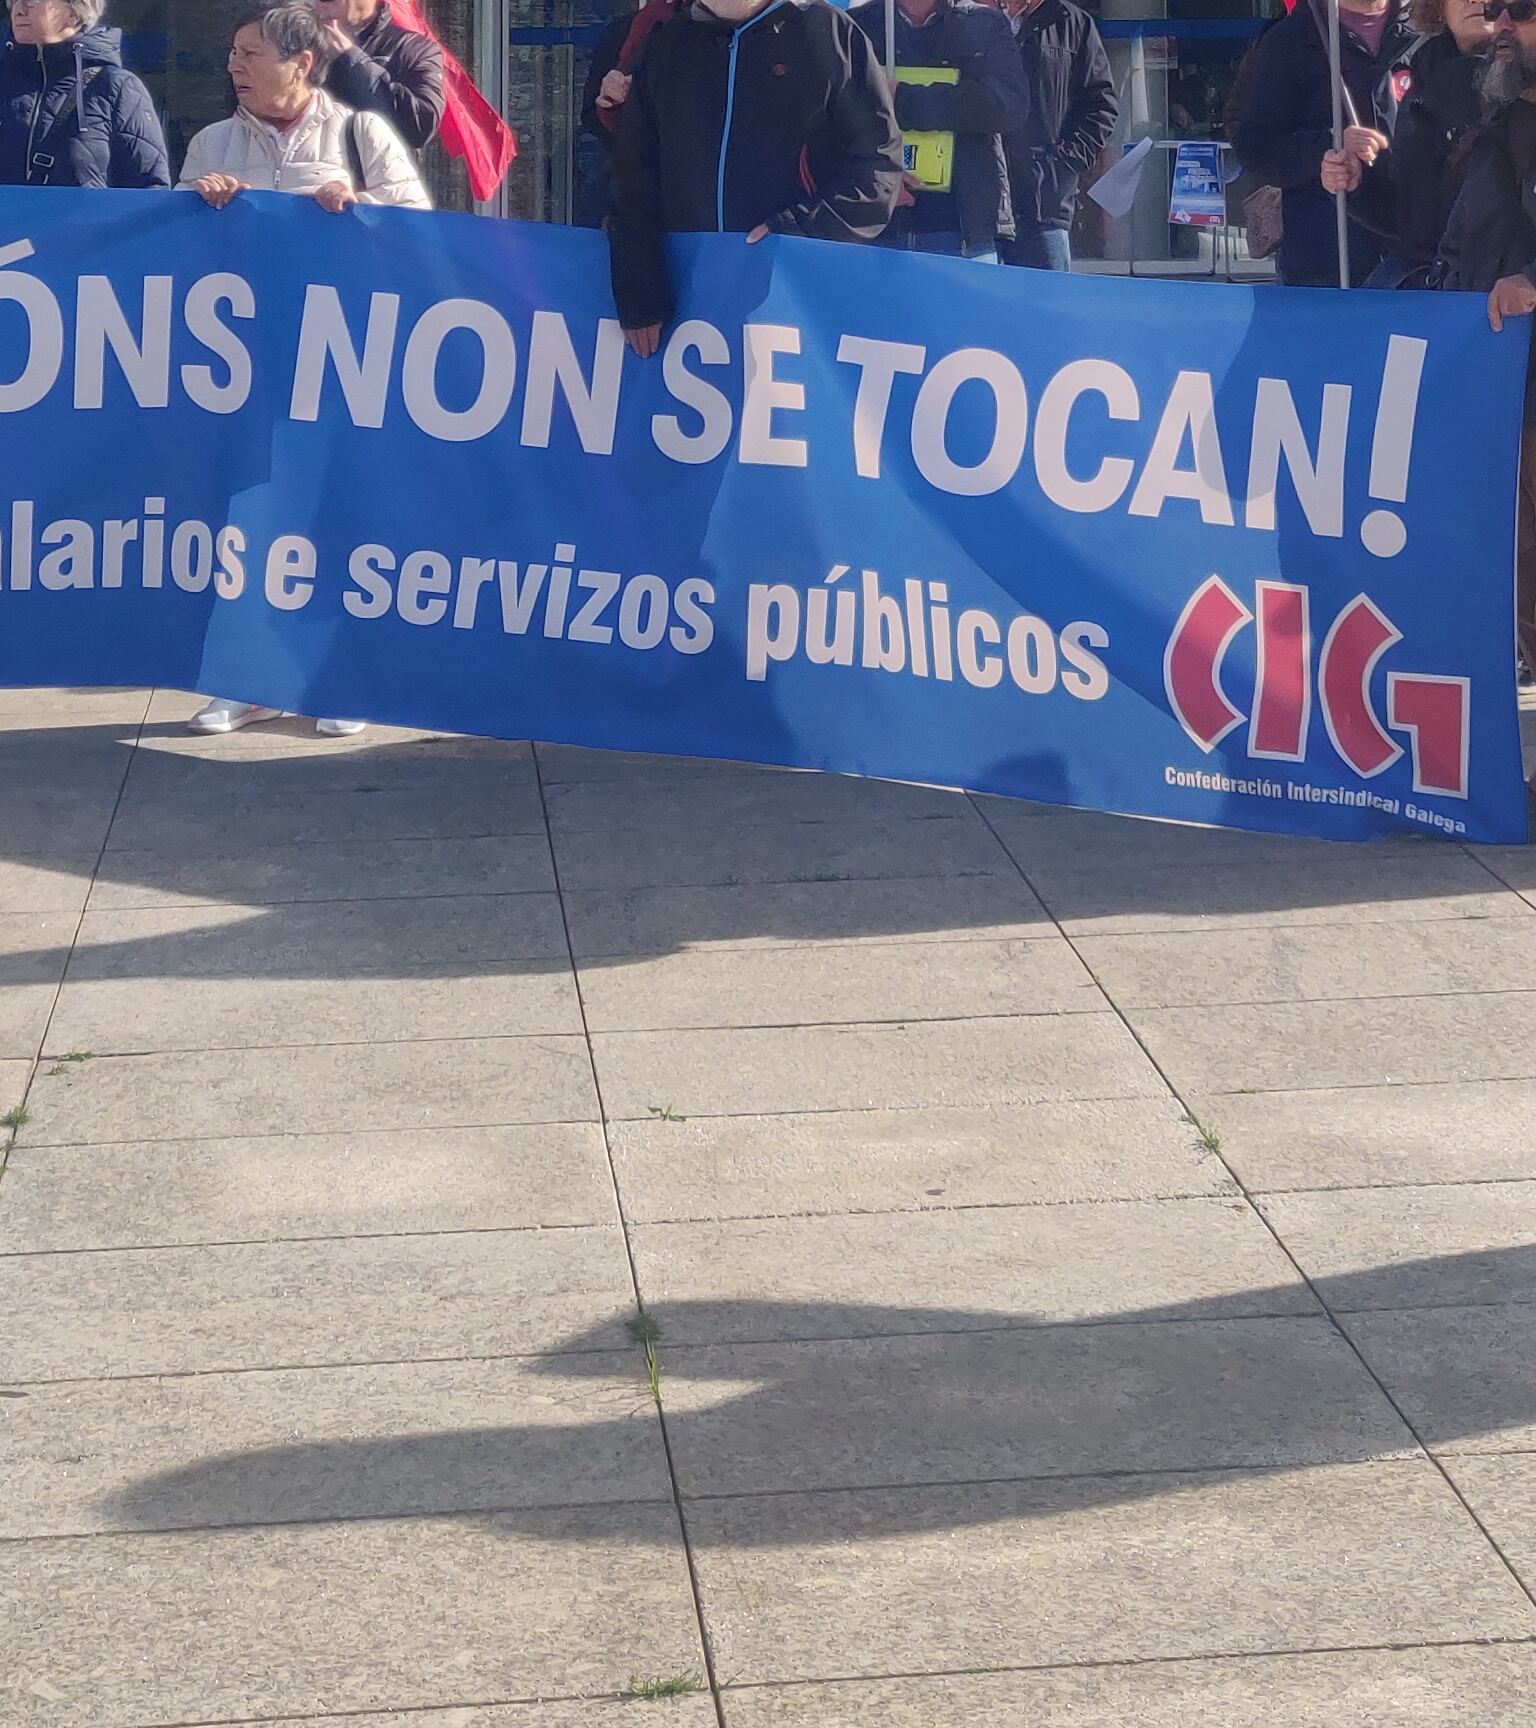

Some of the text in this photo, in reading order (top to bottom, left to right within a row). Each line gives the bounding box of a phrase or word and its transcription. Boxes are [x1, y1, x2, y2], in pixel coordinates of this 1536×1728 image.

[290, 284, 625, 456] NON
[652, 319, 809, 466] SE
[837, 334, 1428, 559] TOCAN!
[265, 534, 317, 611] e
[343, 543, 716, 655] servizos
[746, 564, 1110, 701] públicos
[1164, 573, 1470, 799] CIG
[1164, 765, 1467, 835] Confederación Intersindical Galega
